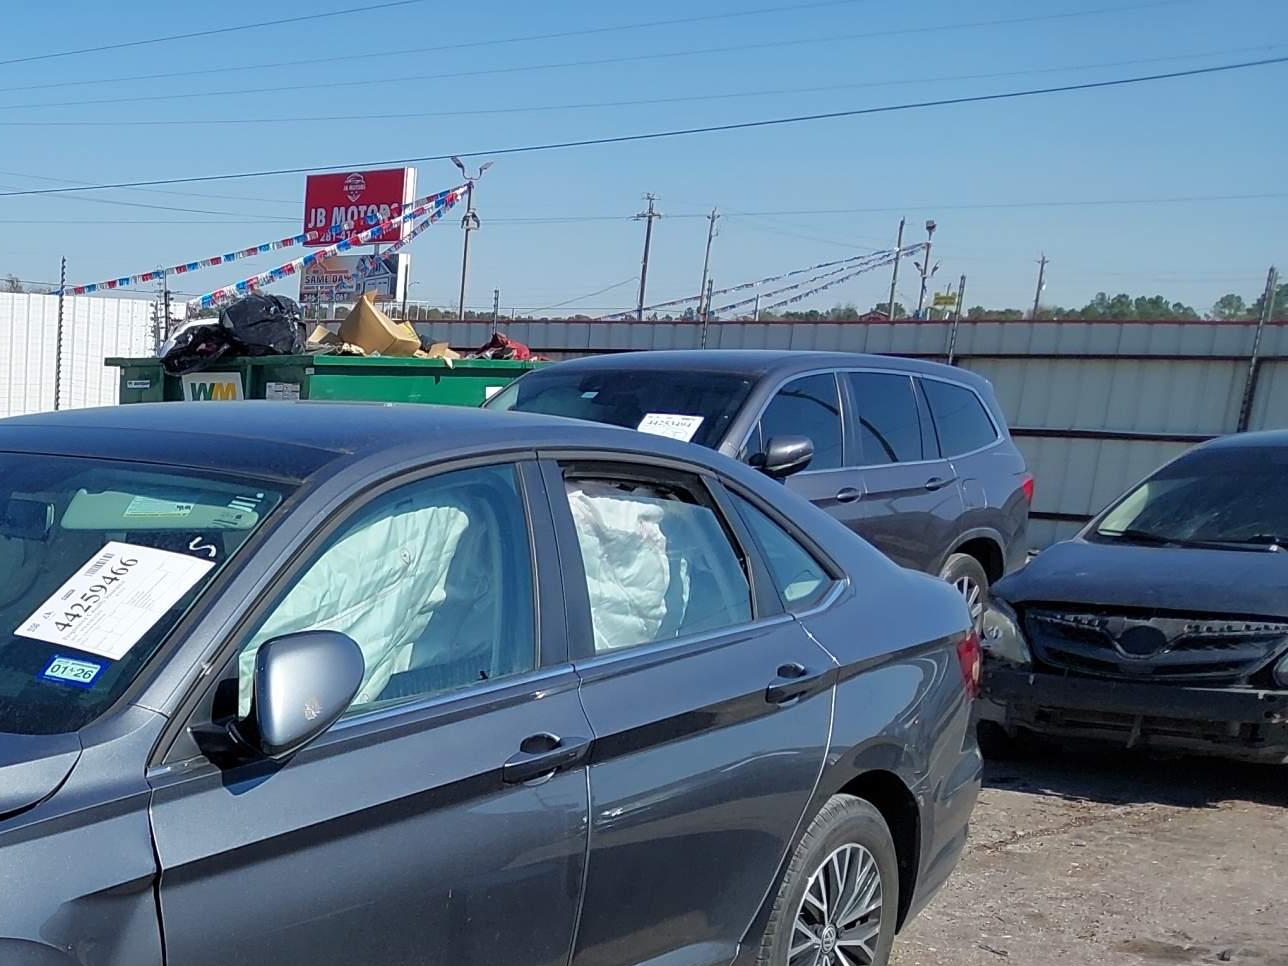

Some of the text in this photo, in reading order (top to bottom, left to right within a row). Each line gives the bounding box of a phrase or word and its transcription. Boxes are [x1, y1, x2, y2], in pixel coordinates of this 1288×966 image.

[308, 208, 326, 228] JB
[190, 382, 237, 400] WM
[55, 556, 138, 631] 44259466
[74, 668, 94, 680] 26
